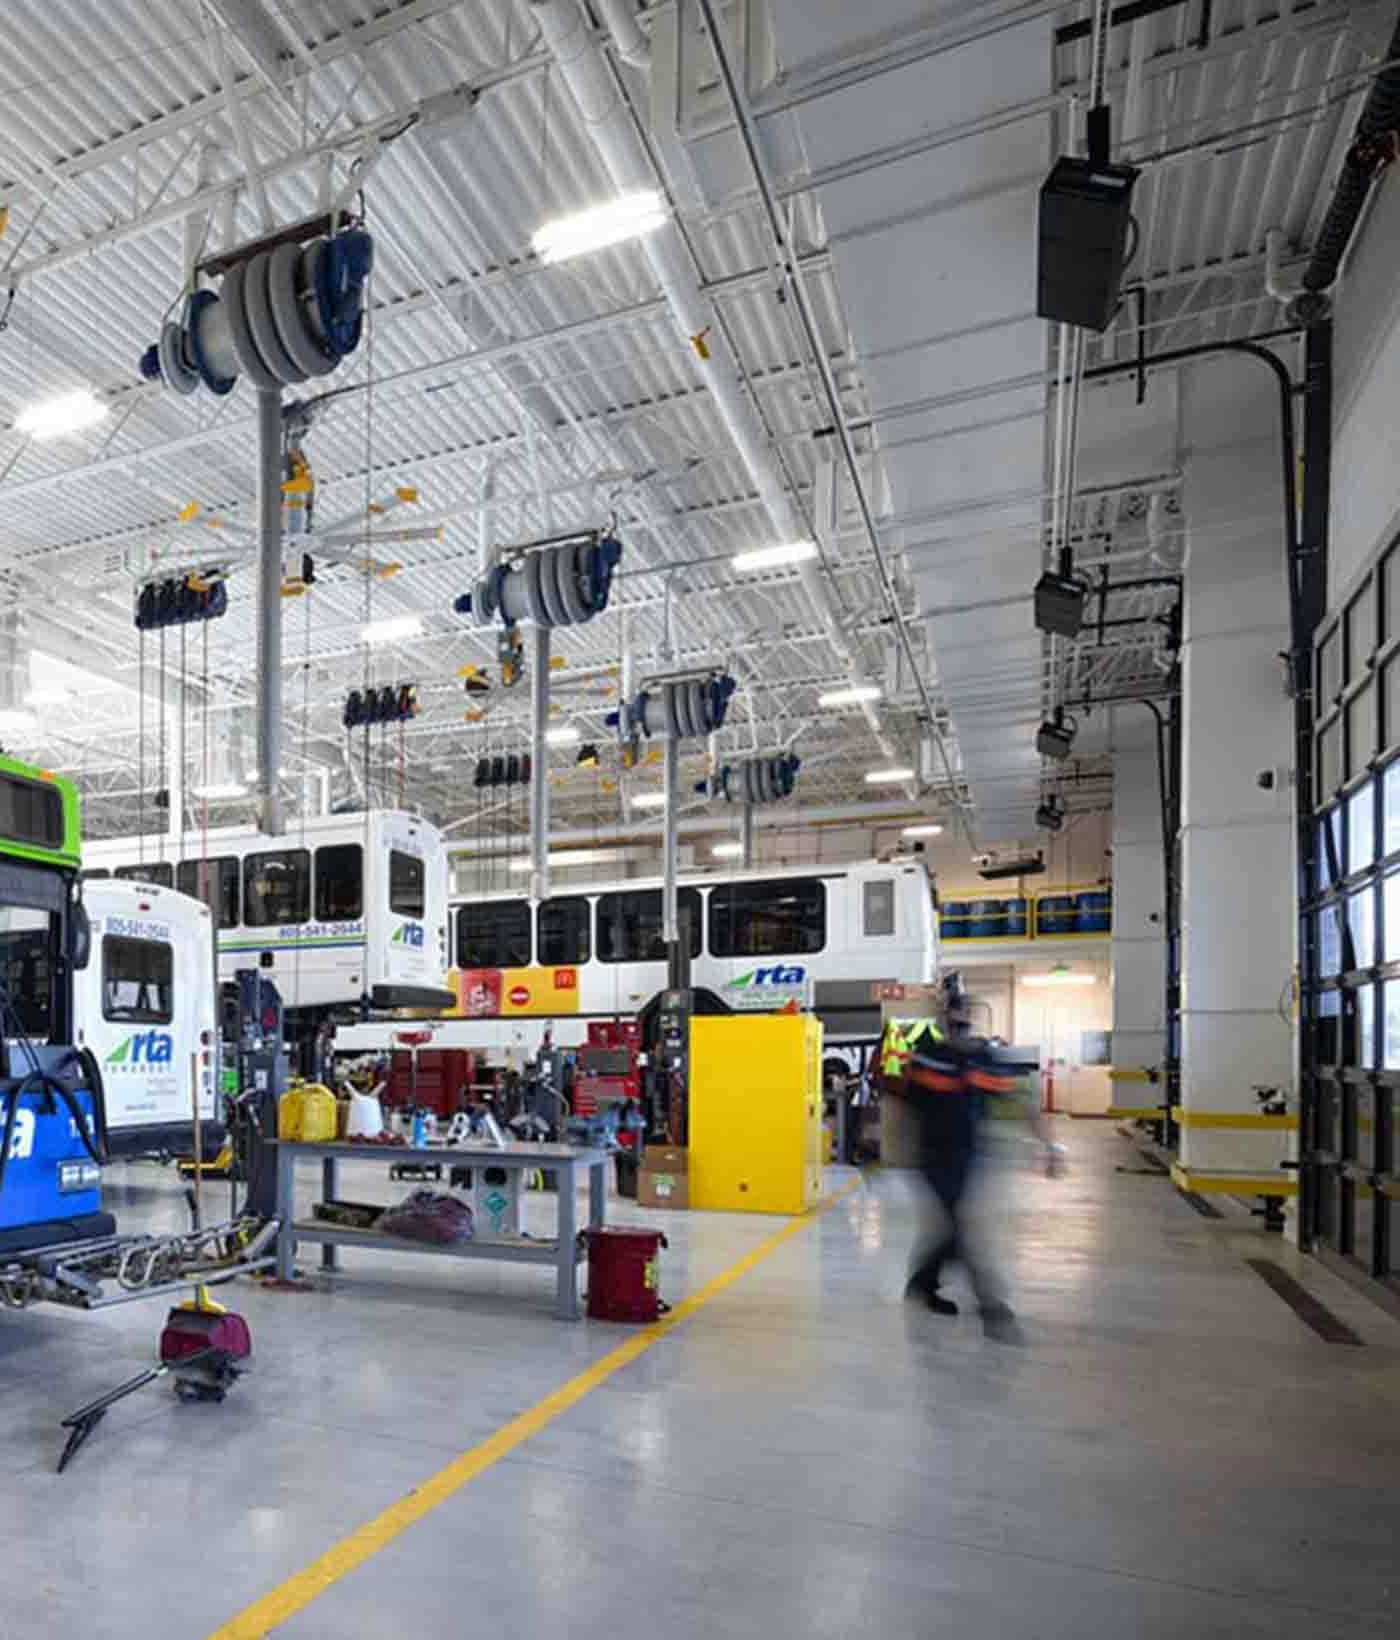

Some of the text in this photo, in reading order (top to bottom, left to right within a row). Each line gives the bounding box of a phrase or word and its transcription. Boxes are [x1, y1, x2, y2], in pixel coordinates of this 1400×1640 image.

[403, 922, 425, 946] rta
[755, 965, 806, 985] rta
[131, 1028, 173, 1063] rta
